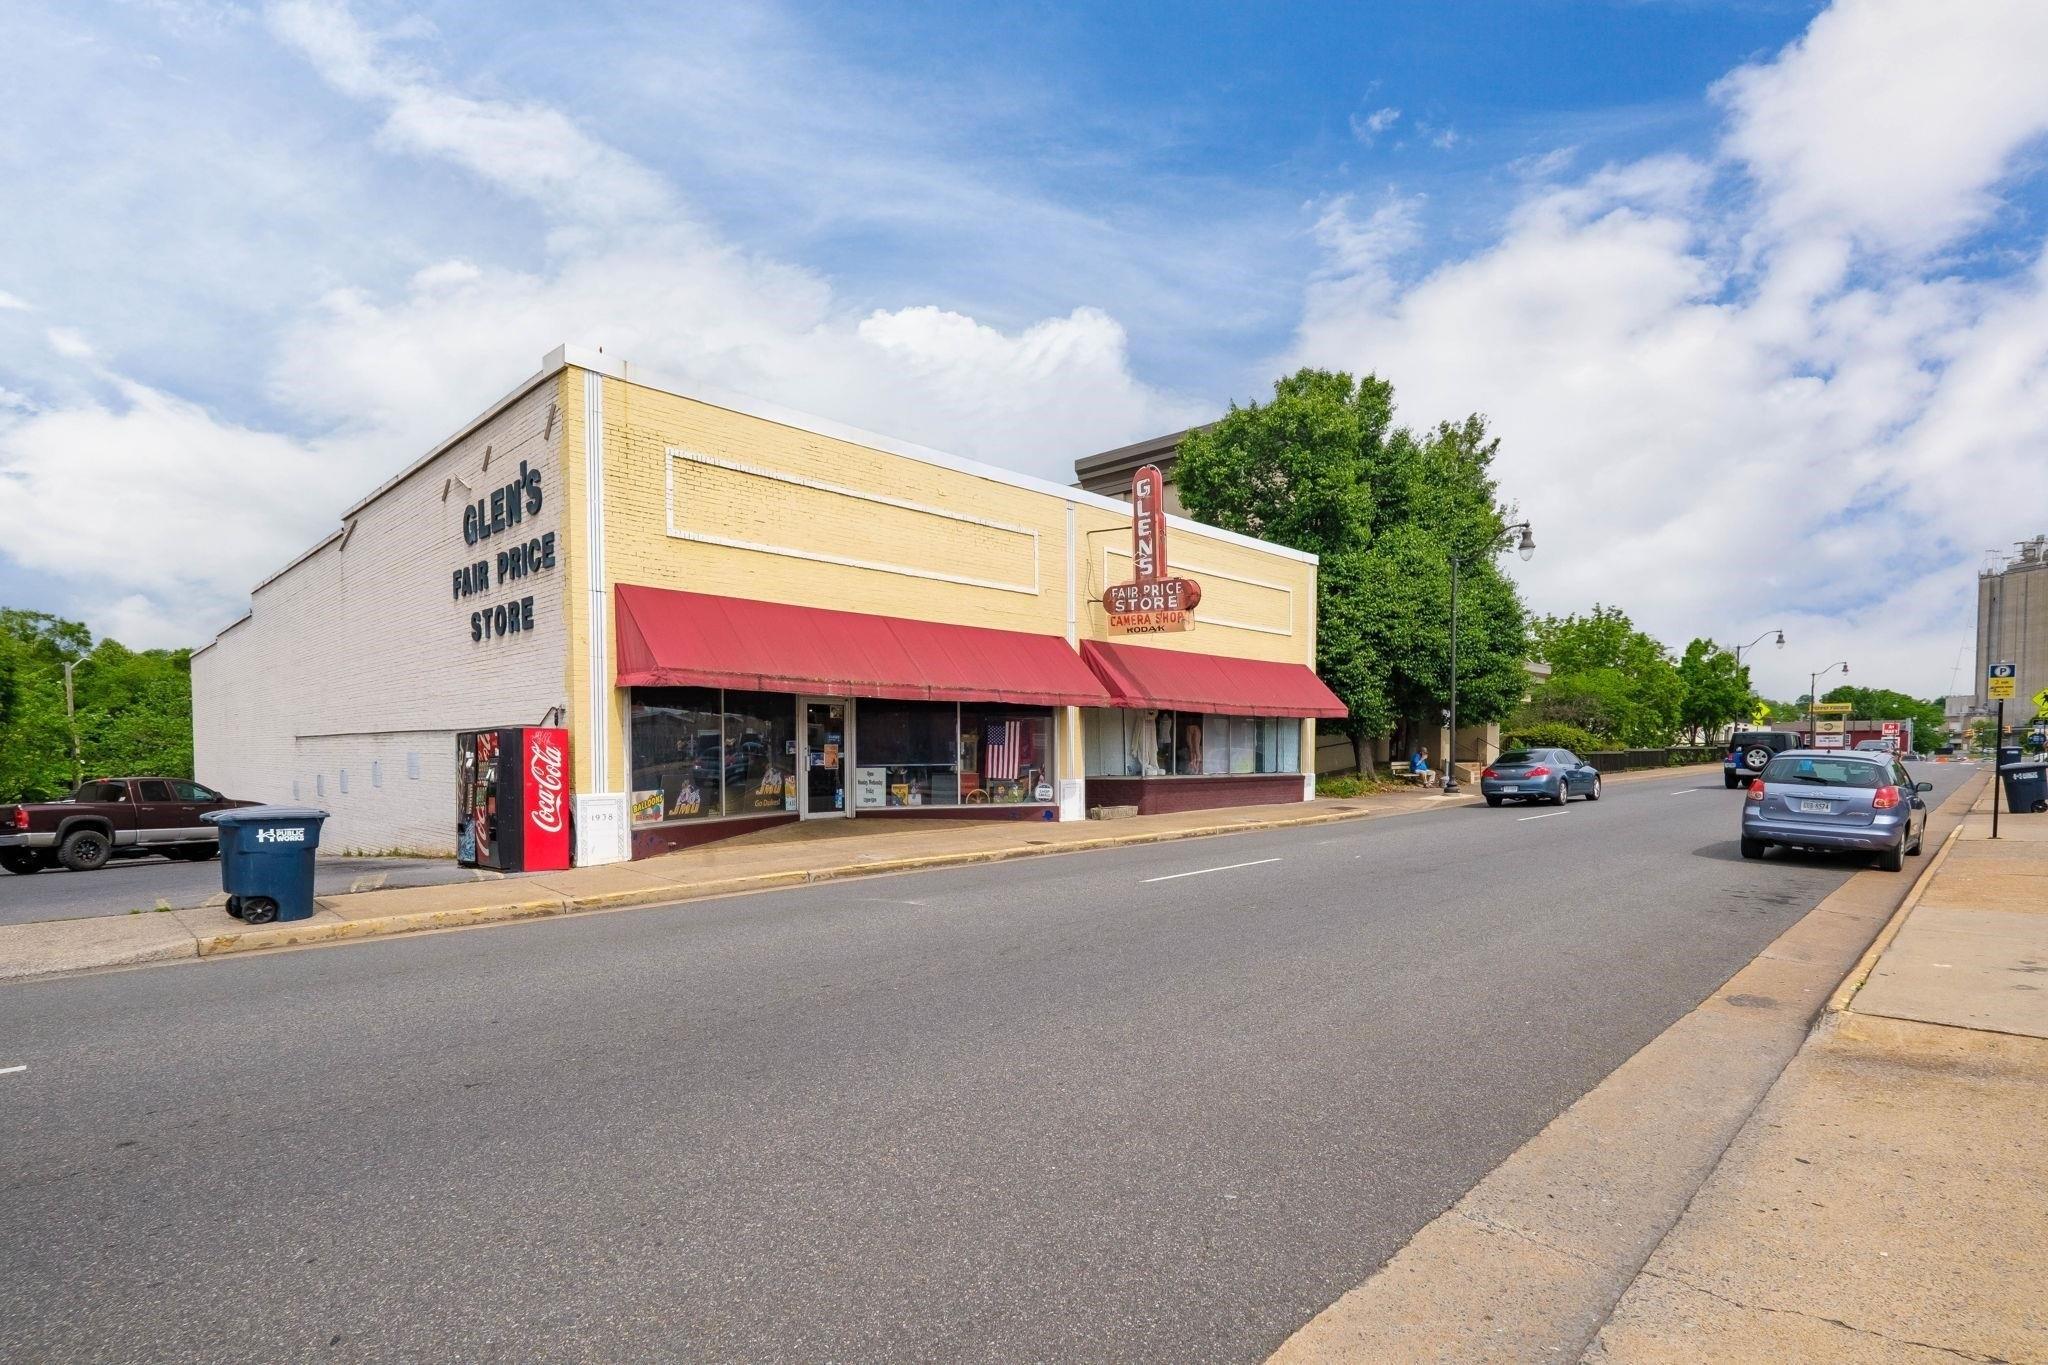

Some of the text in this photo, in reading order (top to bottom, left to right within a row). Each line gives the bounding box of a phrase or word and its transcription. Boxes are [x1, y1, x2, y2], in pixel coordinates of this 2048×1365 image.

[463, 459, 543, 546] GLEN'S
[1136, 478, 1153, 575] GLENS
[452, 531, 556, 600] FAIR PRICE
[1111, 582, 1182, 599] FAIR PRICE
[1115, 595, 1178, 612] STORE
[471, 595, 534, 642] STORE
[1110, 611, 1184, 627] CAMERA SHOP
[1126, 625, 1165, 633] KODAK
[1999, 667, 2007, 676] P
[531, 740, 563, 833] Coca-Cola
[632, 793, 664, 815] BALLOONS
[754, 799, 763, 807] Go
[591, 813, 613, 822] 1938
